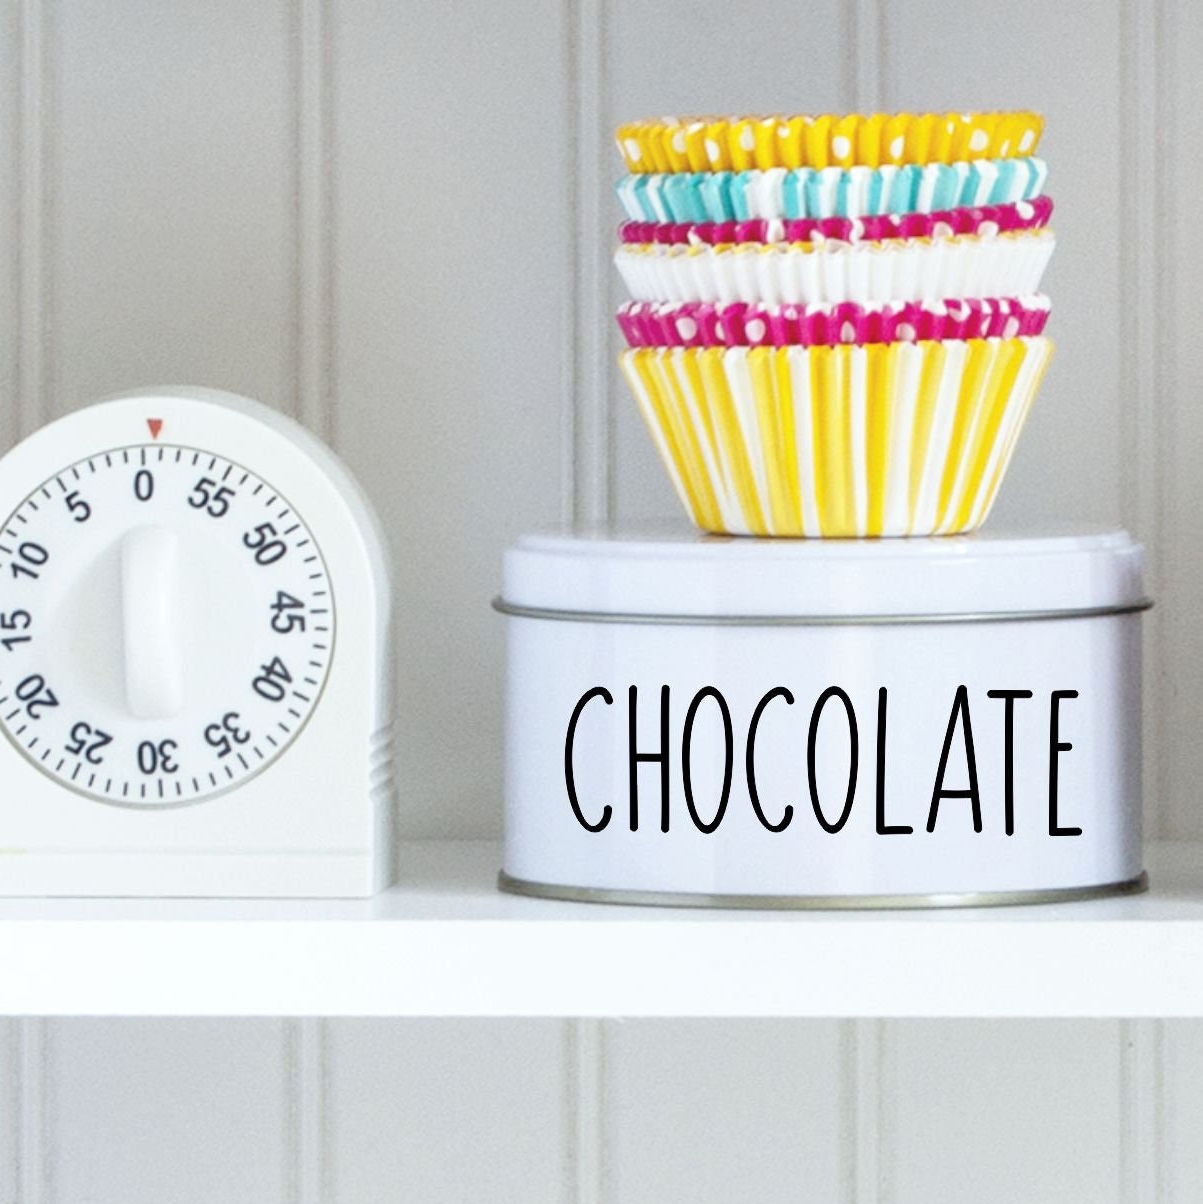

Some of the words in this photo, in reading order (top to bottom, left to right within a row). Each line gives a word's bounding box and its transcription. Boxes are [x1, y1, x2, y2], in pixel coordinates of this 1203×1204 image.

[65, 491, 90, 522] 5
[134, 470, 153, 501] 0
[188, 478, 235, 517] 55
[11, 542, 48, 579] 10
[243, 523, 287, 565] 50
[0, 610, 31, 651] 15
[271, 591, 305, 633] 45
[15, 674, 59, 719] 20
[252, 657, 292, 702] 40
[65, 722, 112, 764] 25
[204, 712, 250, 758] 35
[138, 740, 178, 774] 30
[565, 685, 1082, 836] CHOCOLATE
